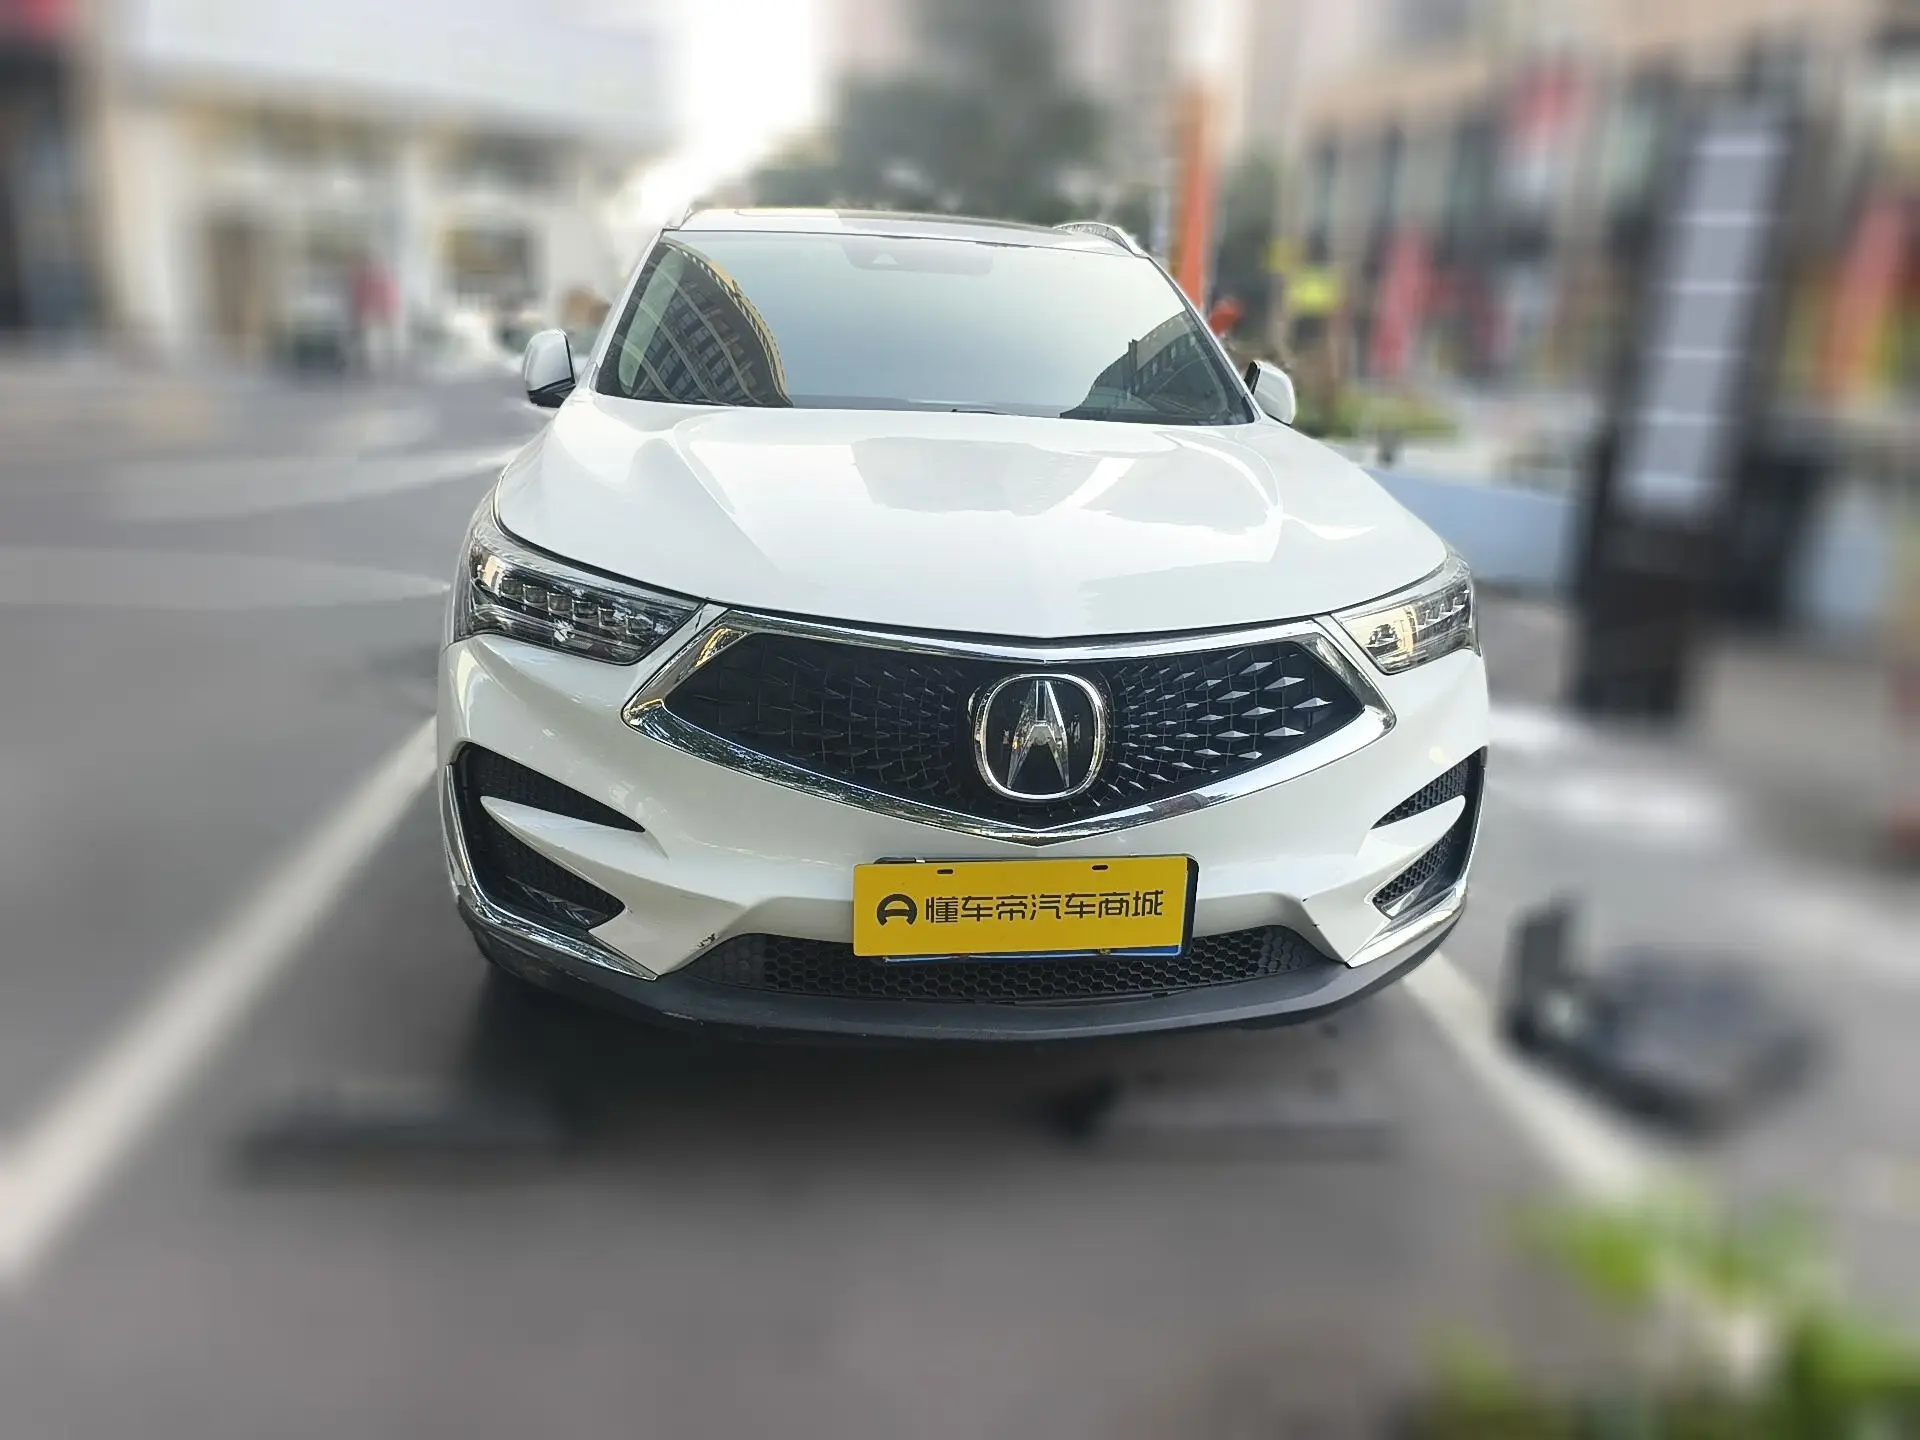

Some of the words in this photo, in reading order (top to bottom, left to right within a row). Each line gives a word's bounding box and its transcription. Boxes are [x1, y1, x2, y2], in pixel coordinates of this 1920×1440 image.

[925, 889, 1164, 923] 懂车帝汽车商城
